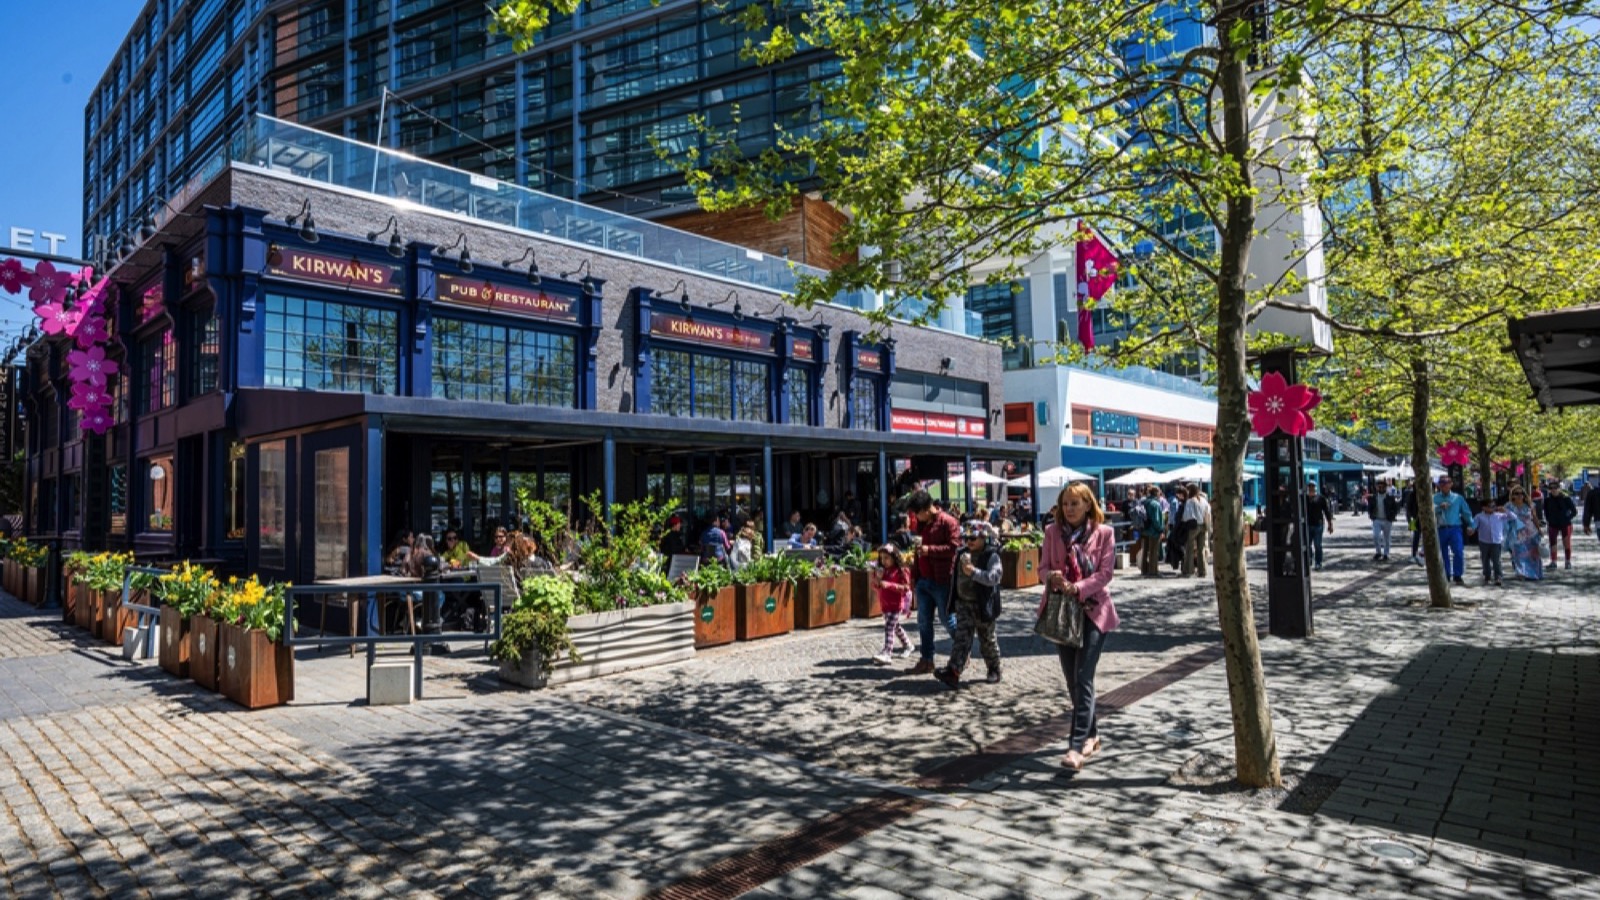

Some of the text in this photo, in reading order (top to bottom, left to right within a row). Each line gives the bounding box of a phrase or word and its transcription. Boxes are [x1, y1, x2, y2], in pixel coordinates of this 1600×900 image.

[292, 254, 383, 284] KIRWAN'S
[450, 283, 478, 297] PUB
[495, 291, 571, 312] RESTAURANT
[671, 320, 723, 339] KIRWAN'S
